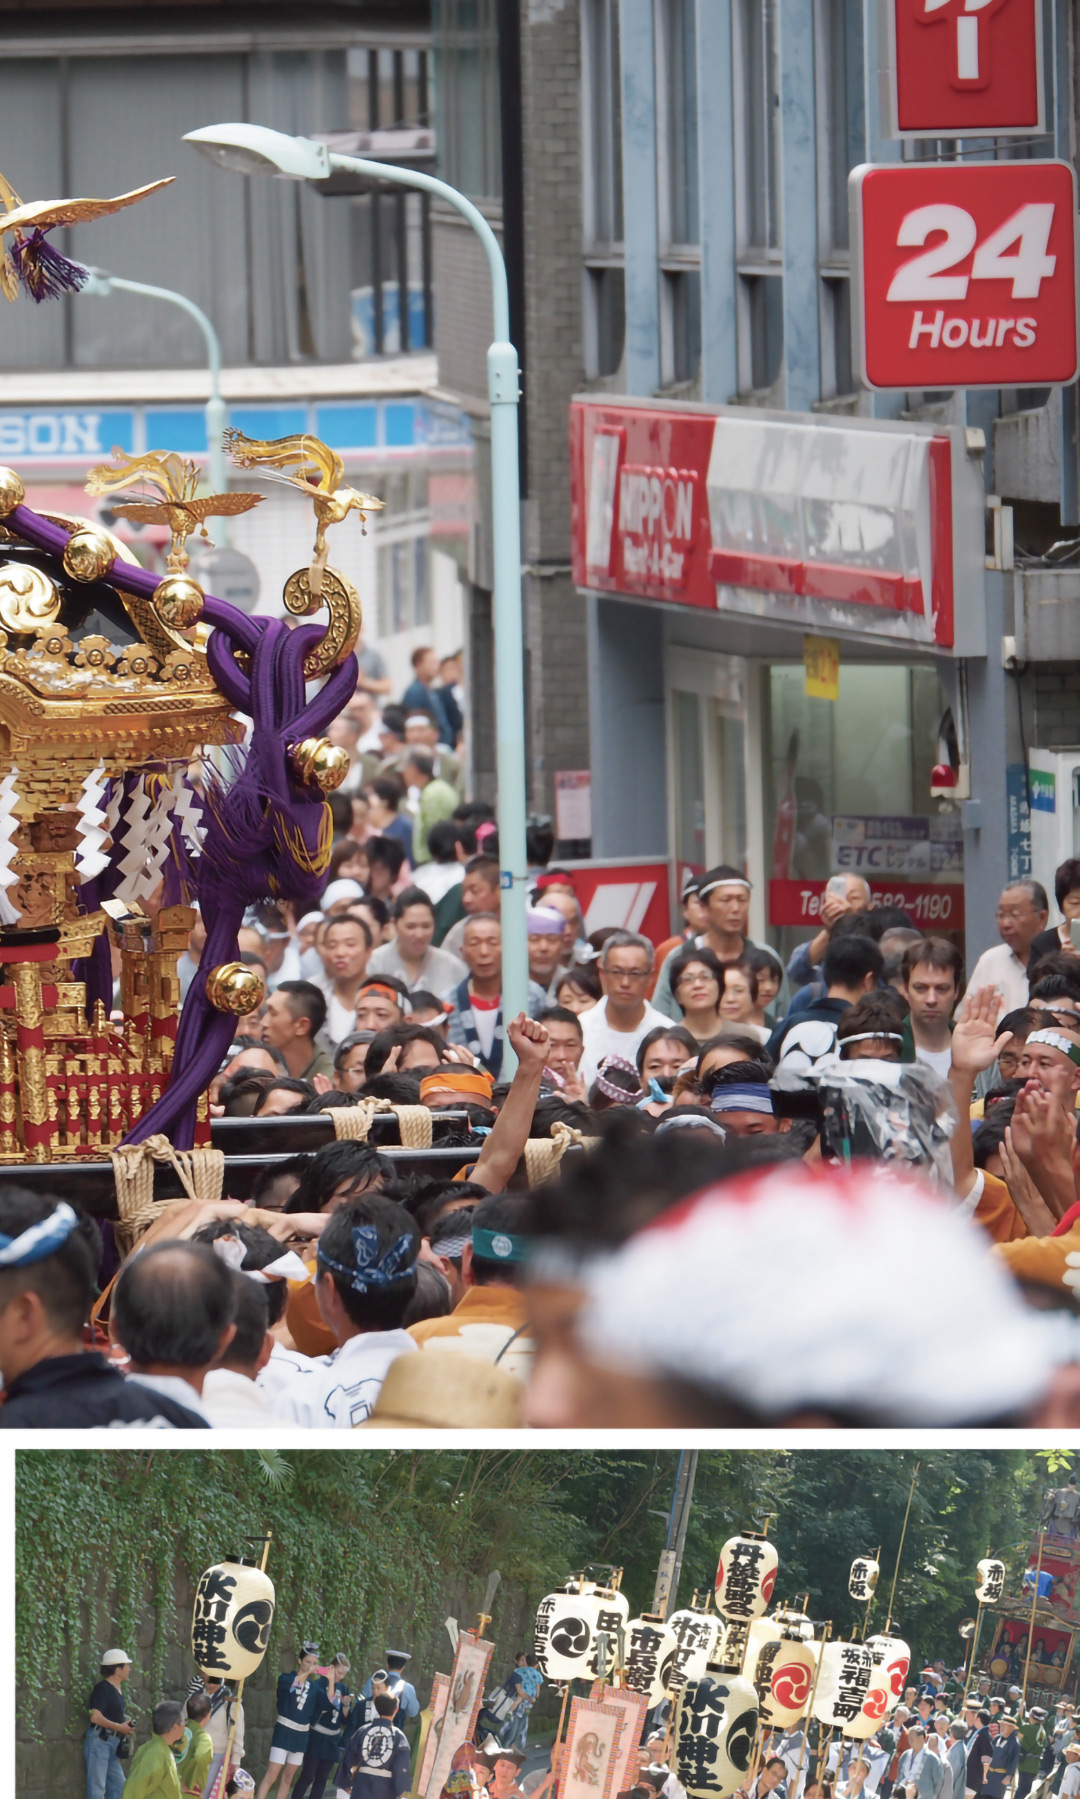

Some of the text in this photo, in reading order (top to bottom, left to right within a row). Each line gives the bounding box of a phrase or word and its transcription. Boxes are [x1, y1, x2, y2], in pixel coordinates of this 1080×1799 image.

[886, 203, 1056, 302] 24
[908, 310, 1037, 349] Hours
[620, 478, 694, 543] NIPPON
[623, 541, 685, 579] Rent-A-Car
[836, 846, 881, 867] ETC
[850, 1561, 869, 1597] 赤坂
[984, 1563, 1004, 1600] 赤坂
[192, 1568, 238, 1672] 氷川神社
[673, 1676, 731, 1792] 氷川神社
